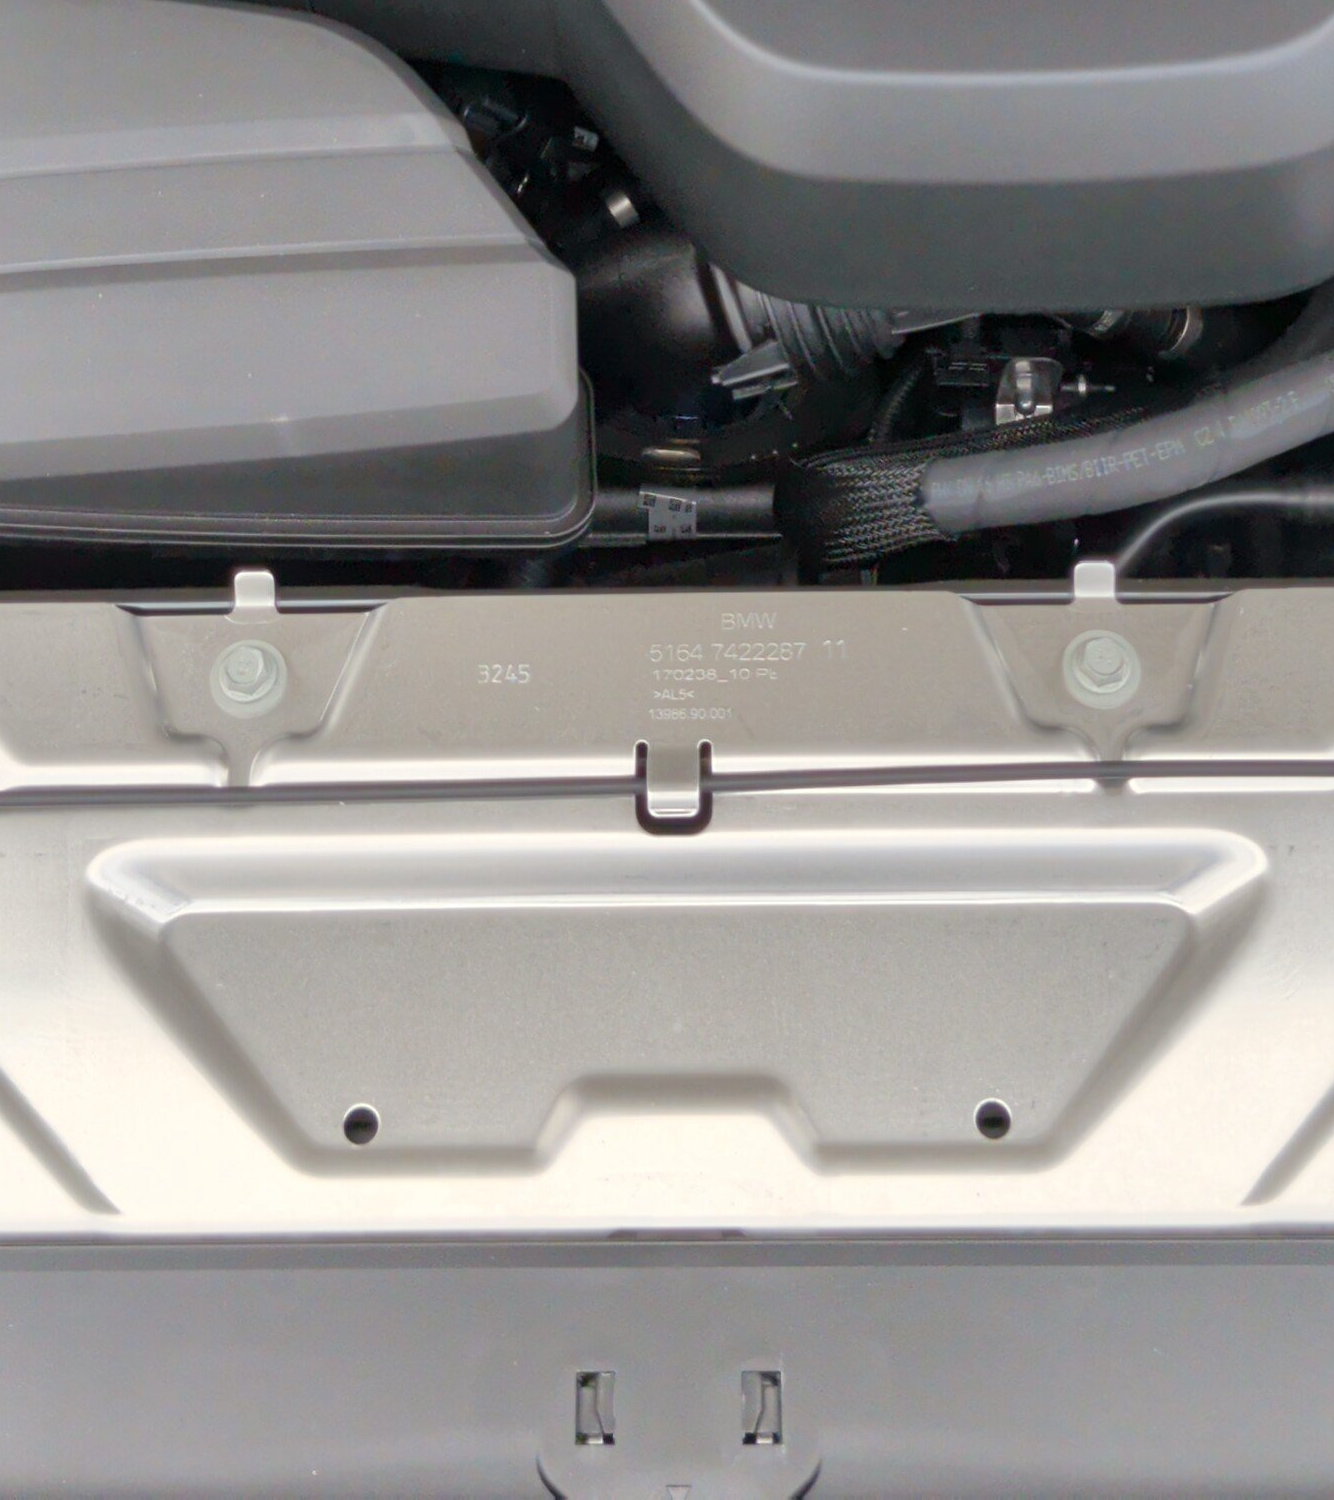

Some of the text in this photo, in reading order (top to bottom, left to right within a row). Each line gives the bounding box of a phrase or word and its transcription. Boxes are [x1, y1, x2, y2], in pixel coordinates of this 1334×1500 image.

[720, 612, 777, 631] BMW
[648, 639, 848, 663] 5164 7422287 11
[477, 663, 531, 685] 3245
